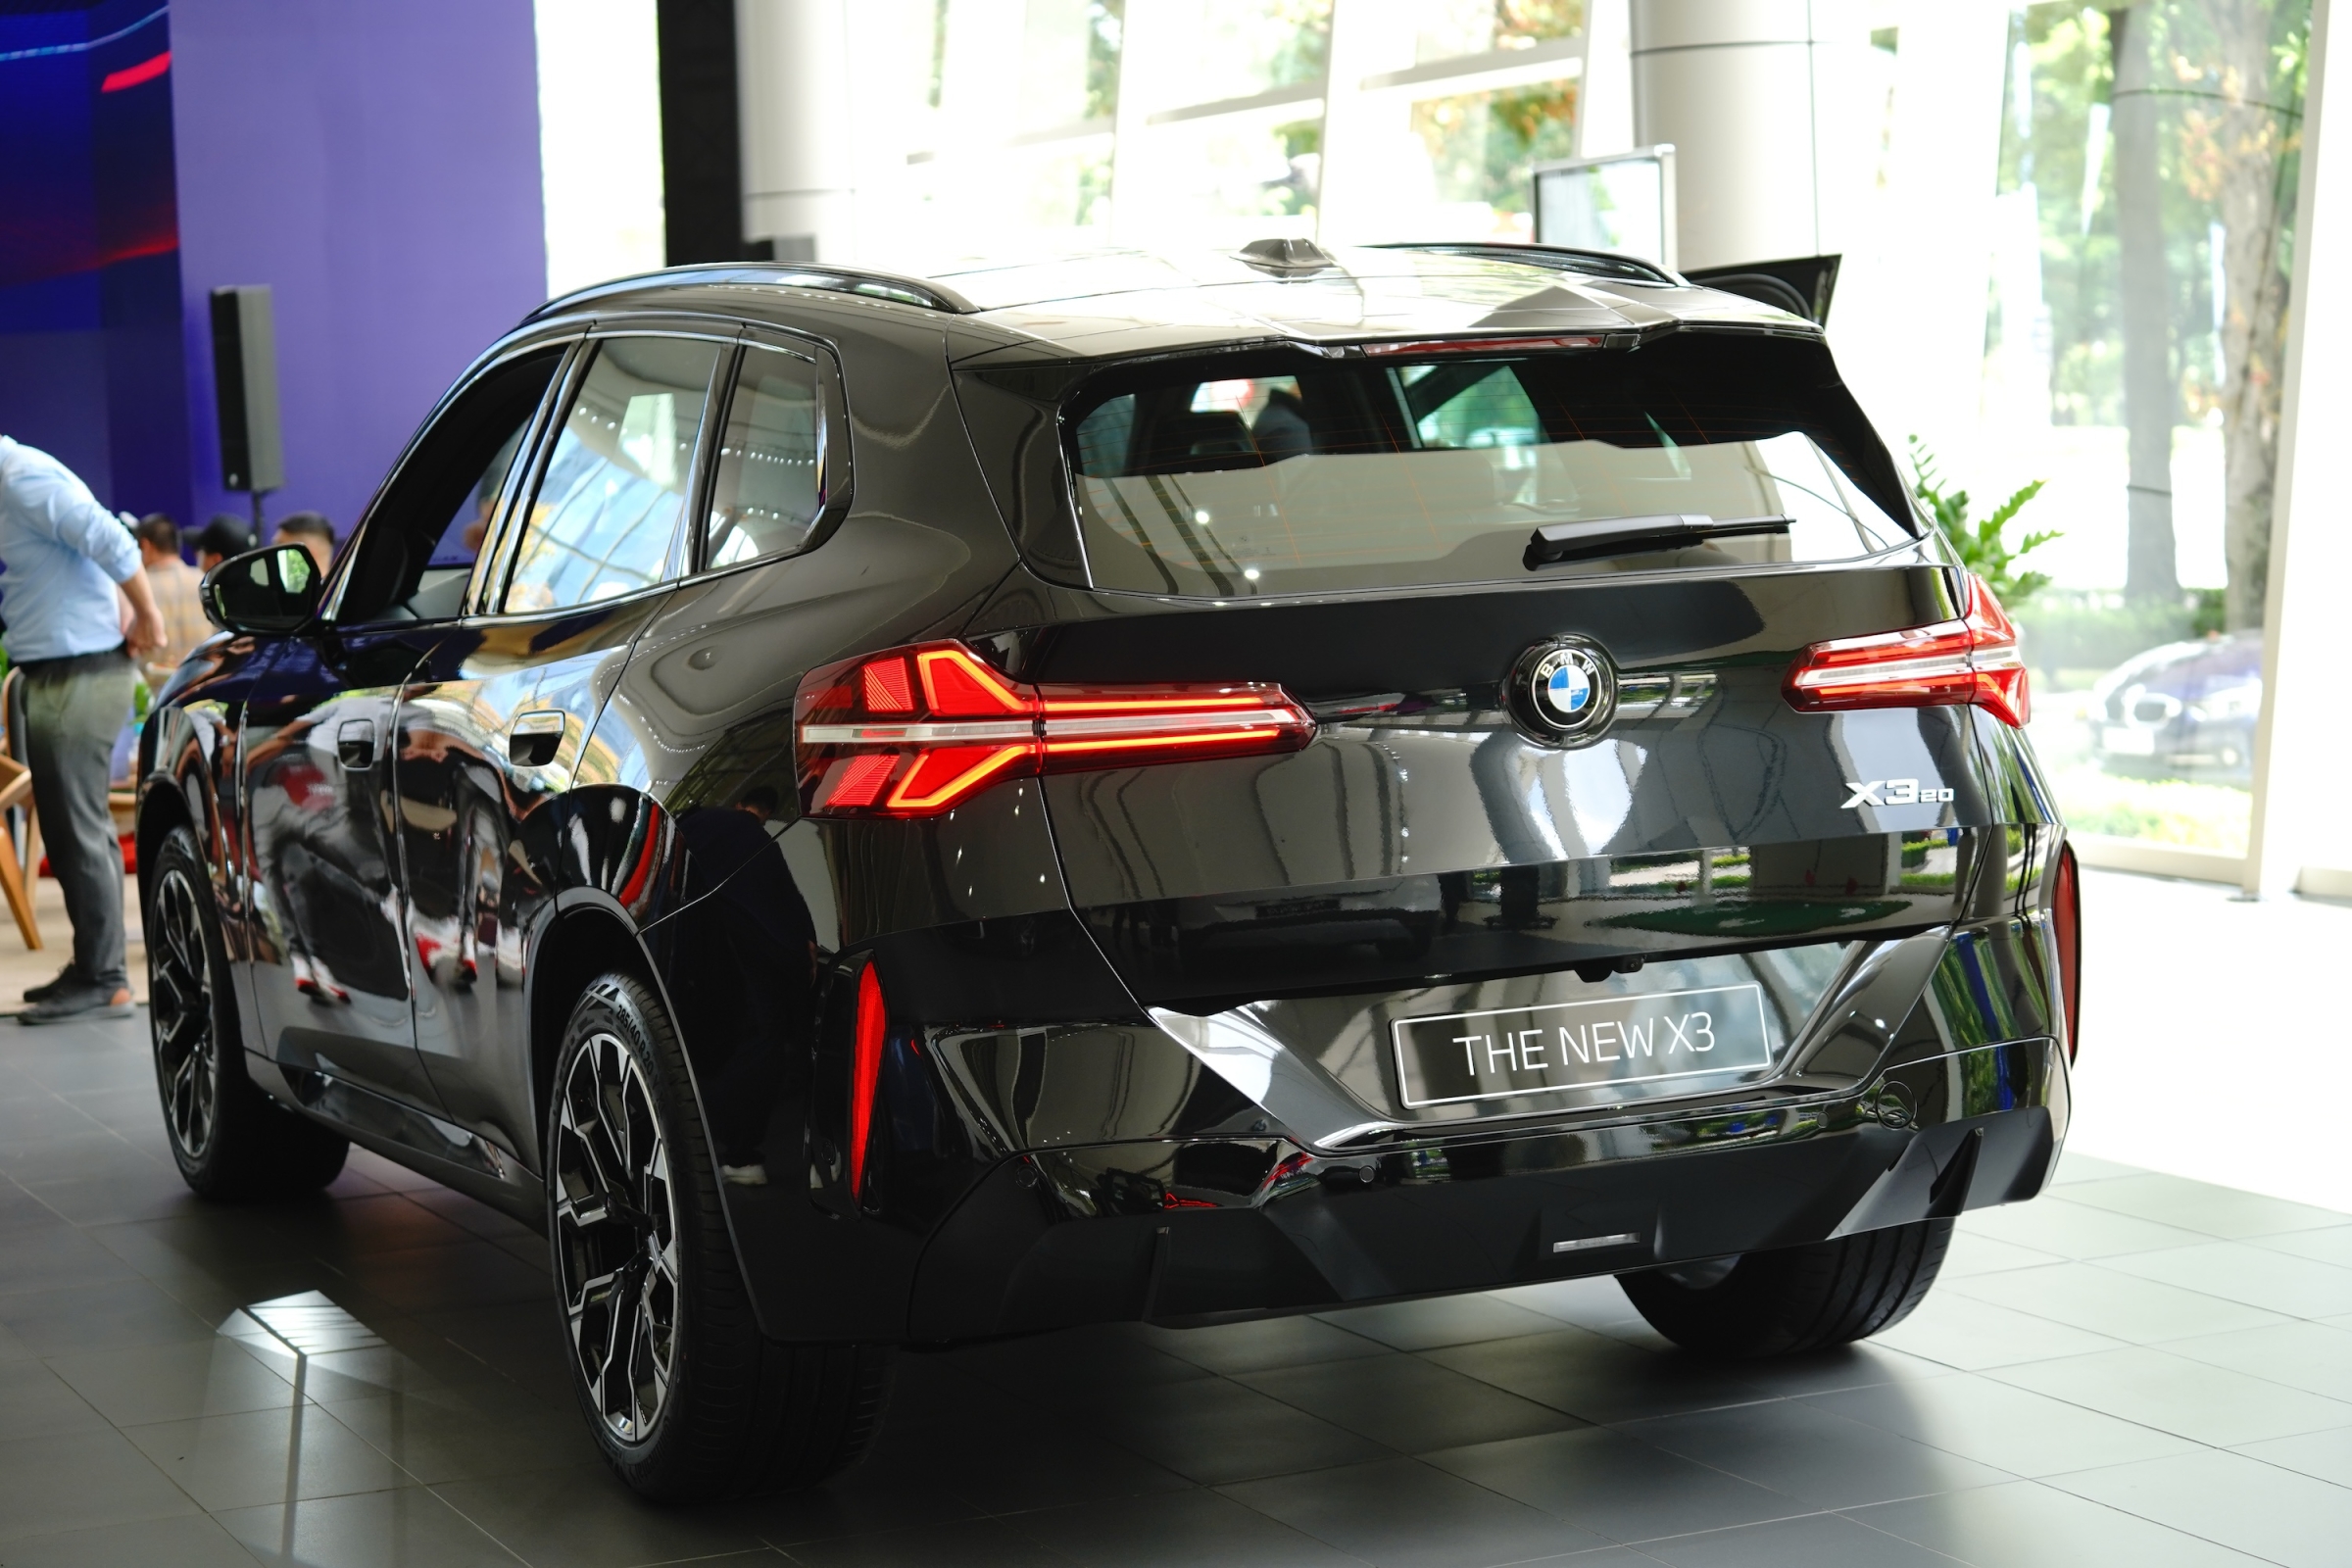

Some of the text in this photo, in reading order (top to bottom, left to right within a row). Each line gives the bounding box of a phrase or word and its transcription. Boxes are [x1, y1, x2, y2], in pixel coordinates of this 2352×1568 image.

[1540, 651, 1595, 679] BMW
[616, 1004, 641, 1045] 285/40
[1452, 1011, 1716, 1076] THE NEW X3
